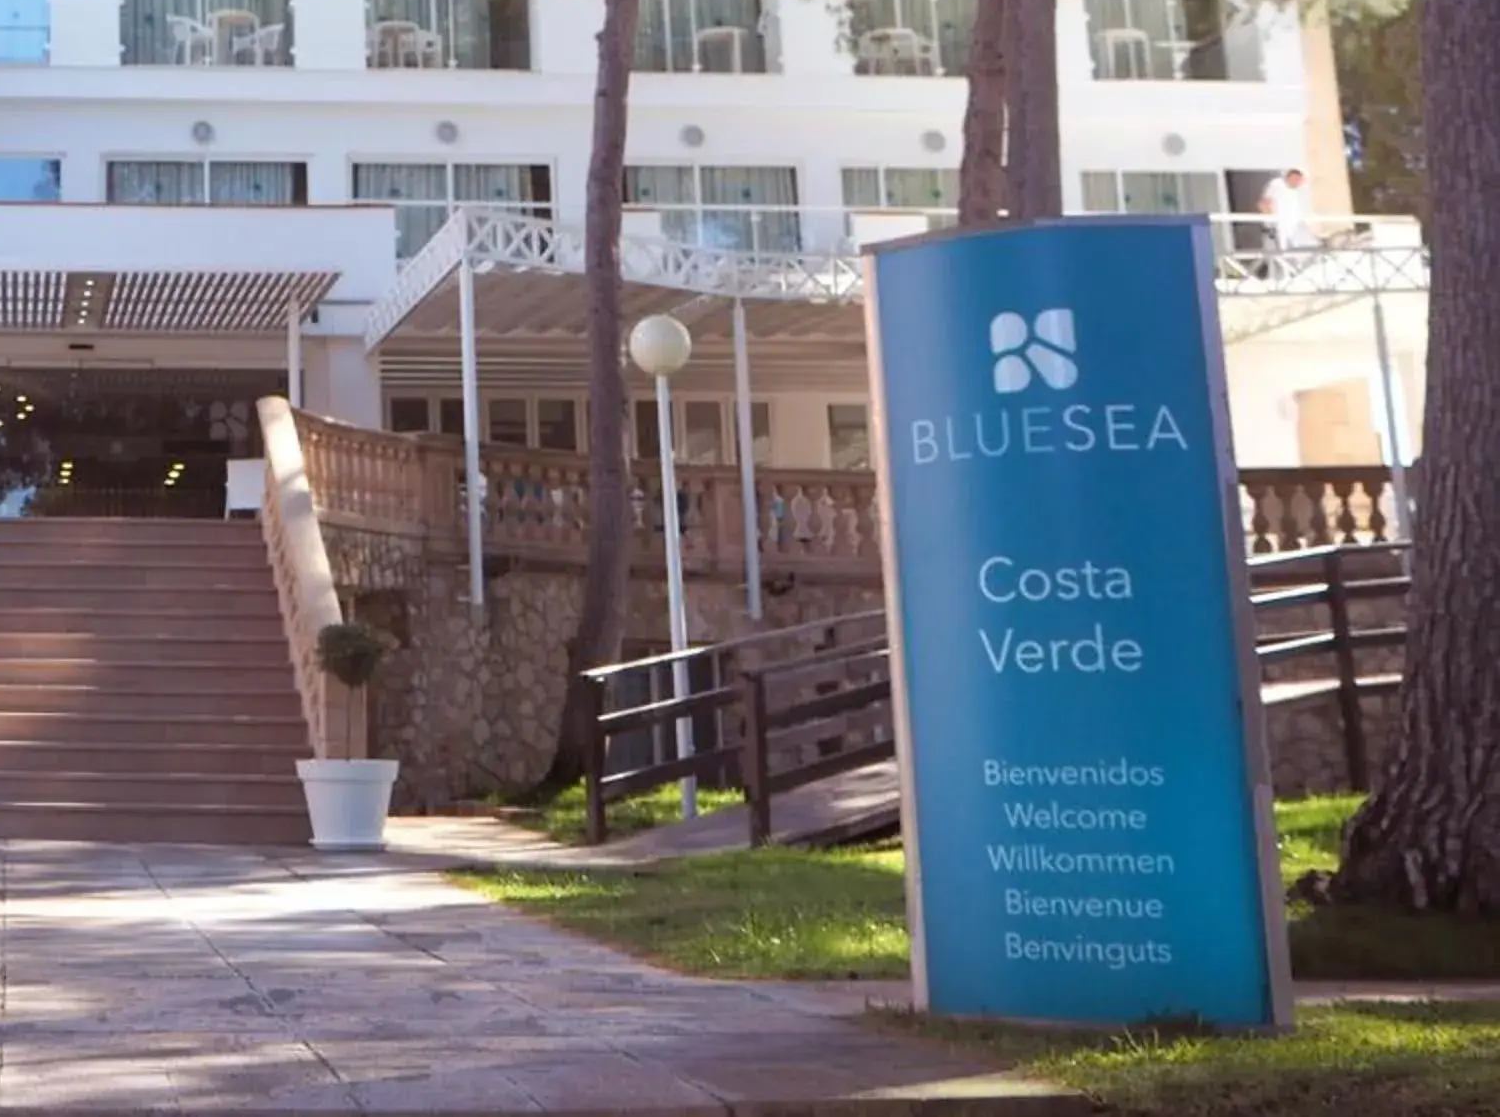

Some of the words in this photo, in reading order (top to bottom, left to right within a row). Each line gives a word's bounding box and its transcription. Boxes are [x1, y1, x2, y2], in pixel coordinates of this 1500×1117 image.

[911, 404, 1189, 464] BLUESEA
[979, 556, 1134, 603] Costa
[979, 623, 1144, 673] Verde
[983, 757, 1165, 787] Bienvenidos
[1003, 800, 1148, 830] Welcome
[985, 842, 1176, 874] Willkommen
[1004, 887, 1164, 919] Bienvenue
[1004, 931, 1173, 970] Benvinguts
